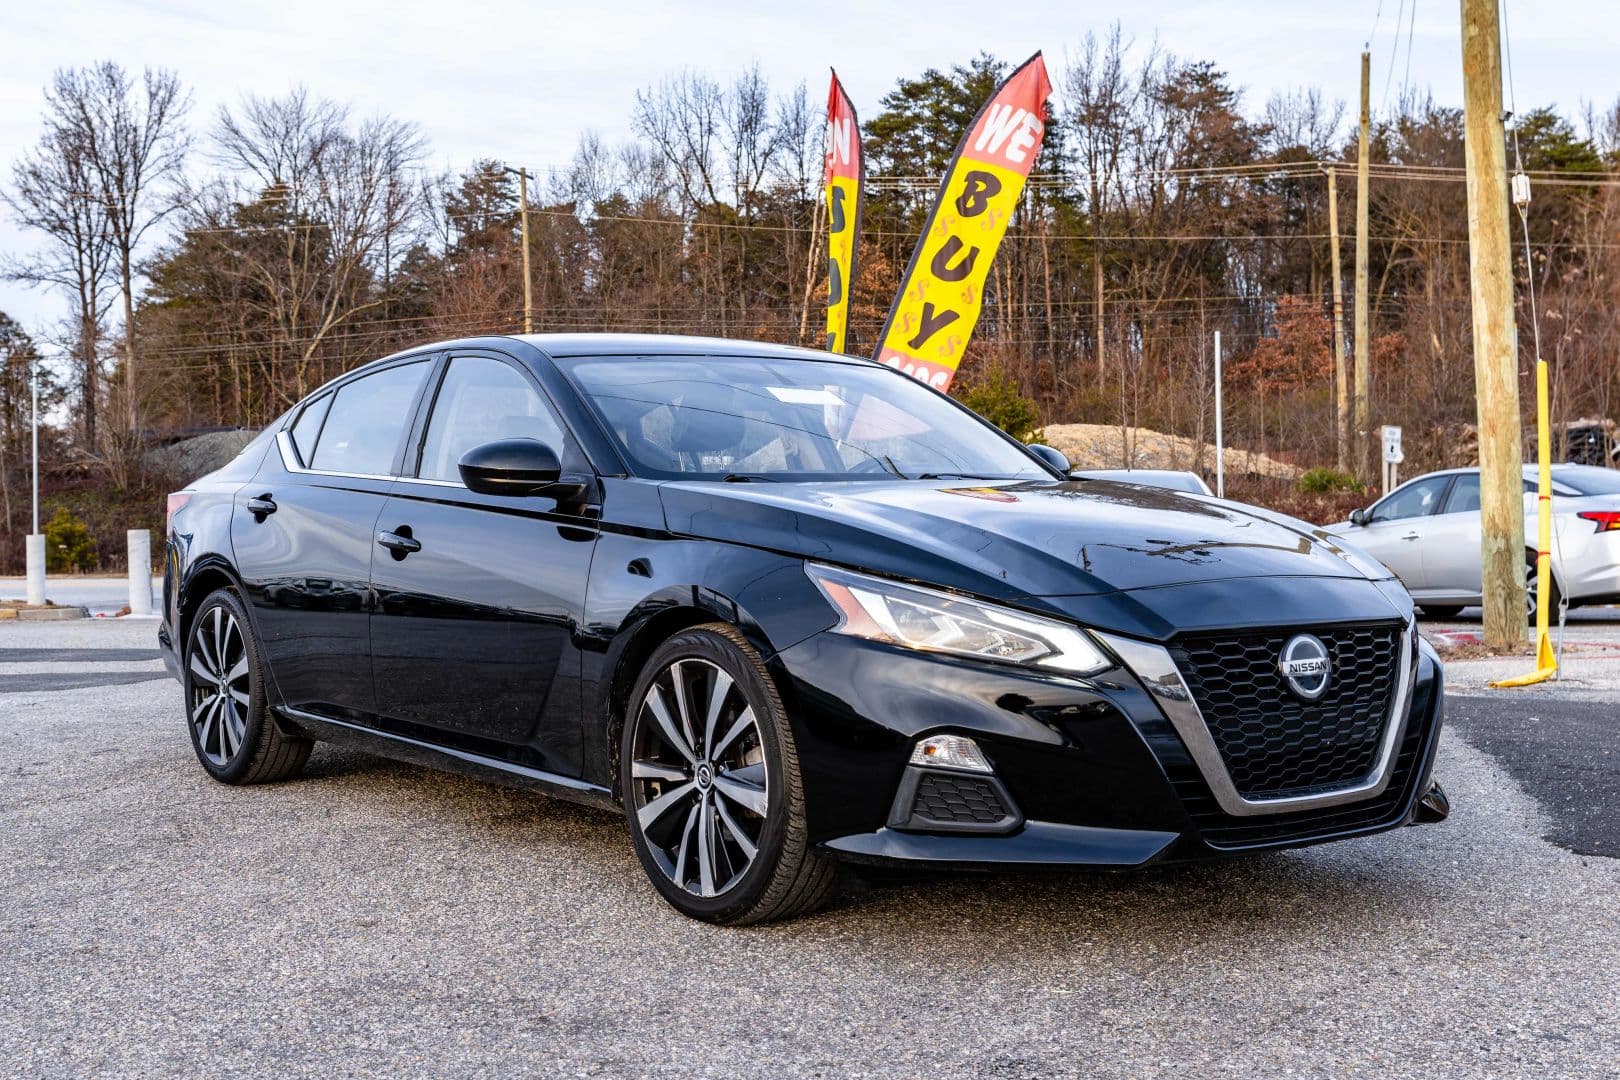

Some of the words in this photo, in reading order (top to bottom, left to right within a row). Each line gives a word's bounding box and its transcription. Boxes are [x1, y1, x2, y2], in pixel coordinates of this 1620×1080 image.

[974, 103, 1043, 163] WE
[907, 170, 1002, 350] BUY
[1289, 661, 1327, 673] NISSAN
